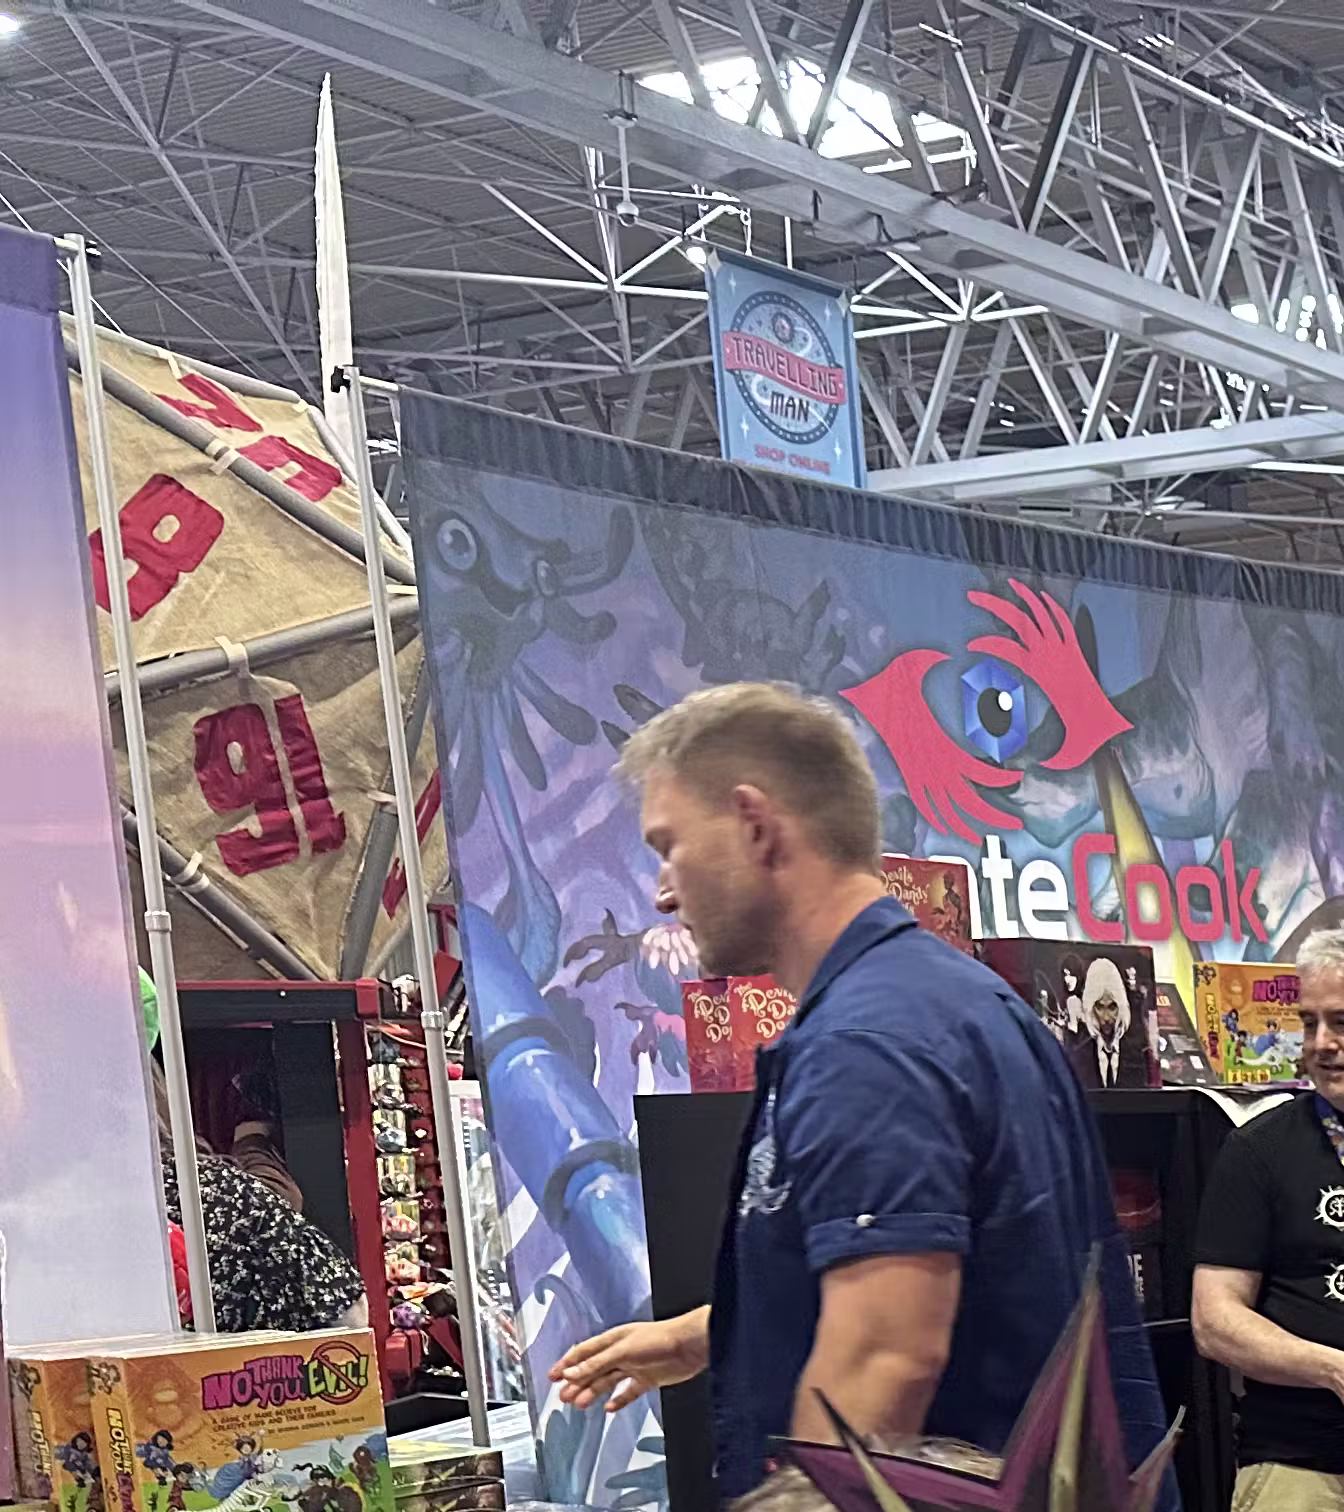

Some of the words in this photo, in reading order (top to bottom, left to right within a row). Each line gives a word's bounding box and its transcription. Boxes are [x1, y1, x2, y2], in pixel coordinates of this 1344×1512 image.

[732, 336, 837, 397] TRAVELLING
[769, 390, 810, 422] MAN
[245, 1355, 305, 1385] THANK
[202, 1370, 252, 1411] NO
